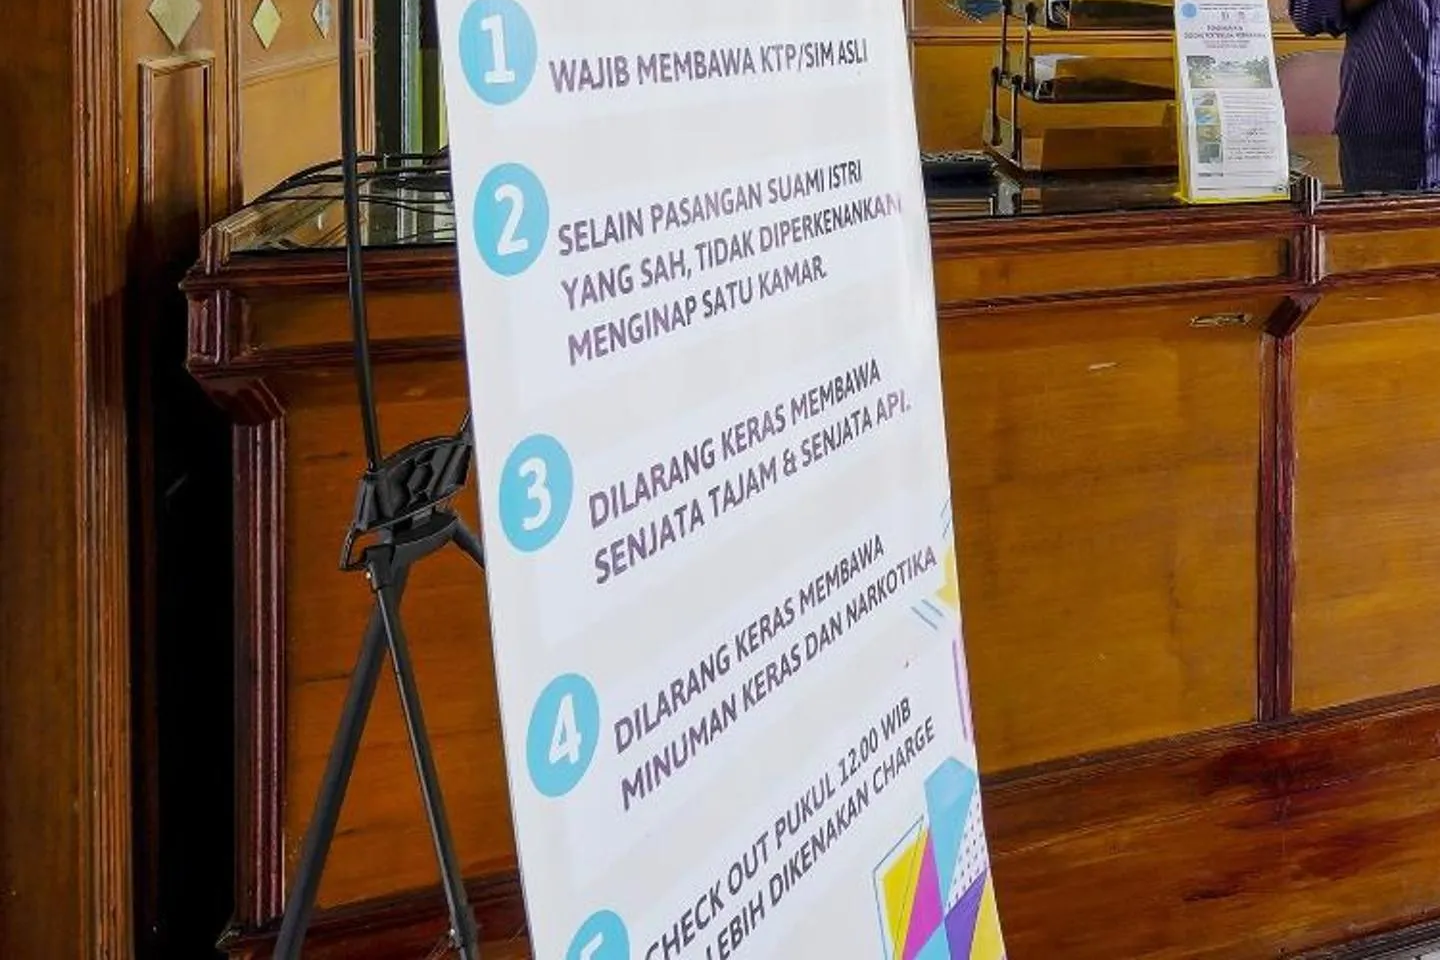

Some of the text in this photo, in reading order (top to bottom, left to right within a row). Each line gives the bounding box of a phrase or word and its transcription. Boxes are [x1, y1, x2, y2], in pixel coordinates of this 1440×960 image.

[481, 14, 515, 84] 1
[549, 38, 867, 93] WAJIB MEMBAWA KTP/SIM ASLI
[495, 184, 529, 255] 2
[558, 159, 862, 256] SELAIN PASANGAN SUAMI ISTRI
[561, 193, 902, 311] YANG SAH, TIDAK DIPERKENANKAN
[568, 295, 698, 366] MENGINAP
[702, 276, 752, 318] SATU
[517, 456, 551, 531] 3
[589, 358, 881, 529] DILARANG KERAS MEMBAWA
[594, 499, 705, 584] SENJATA
[708, 456, 777, 518] TAJAM
[783, 448, 797, 477] &
[801, 406, 872, 467] SENJATA
[614, 534, 884, 754] DILARANG KERAS MEMBAWA
[621, 545, 937, 811] MINUMAN KERAS DAN NARKOTIKA
[548, 693, 581, 765] 4
[727, 831, 769, 896] OUT
[775, 773, 836, 850] PUKUL
[838, 727, 879, 786] 12.00
[881, 696, 911, 741] WIB
[769, 781, 869, 909] DIKENAKAN
[873, 715, 935, 794] CHARGE
